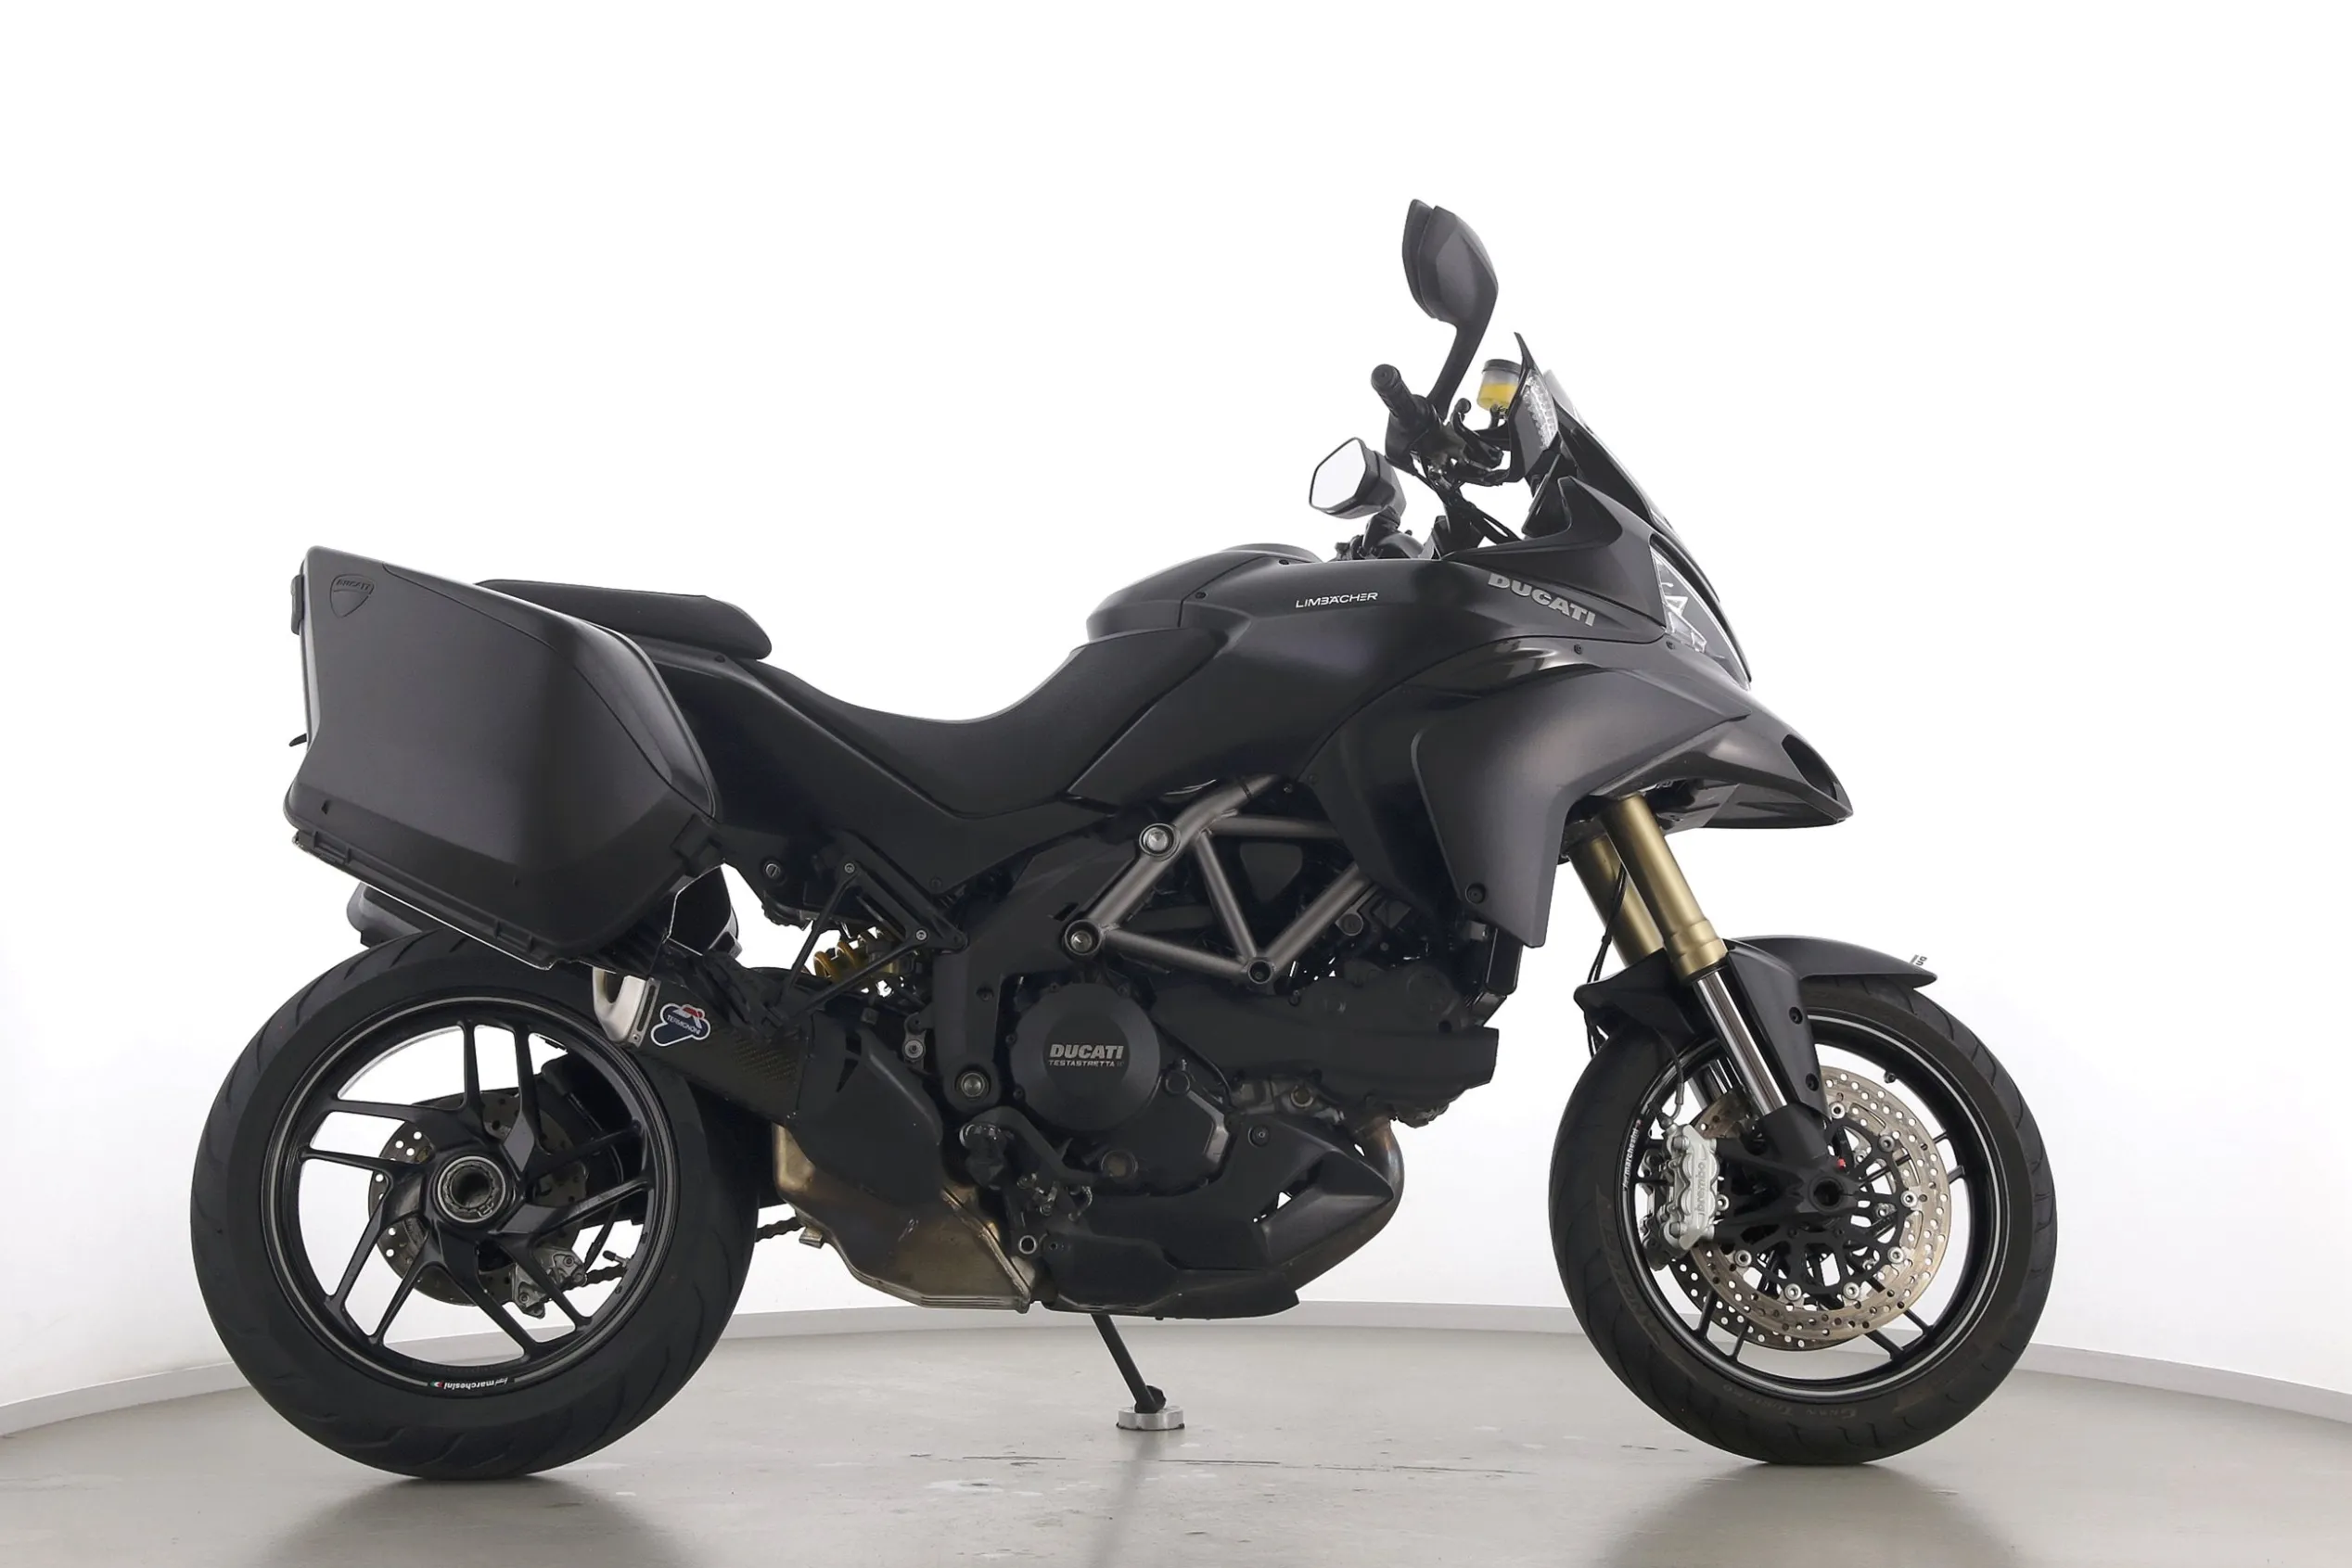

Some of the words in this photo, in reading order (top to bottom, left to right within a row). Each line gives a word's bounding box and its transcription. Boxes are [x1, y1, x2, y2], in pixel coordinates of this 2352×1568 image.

[1296, 592, 1378, 608] LIMBÄCHER
[1488, 573, 1595, 627] DUCATI
[667, 1014, 701, 1036] TERMIGNONI
[1049, 1043, 1124, 1059] DUCATI
[1625, 1128, 1639, 1176] marchesini
[1696, 1161, 1707, 1211] brembo
[444, 1380, 494, 1390] marchesini
